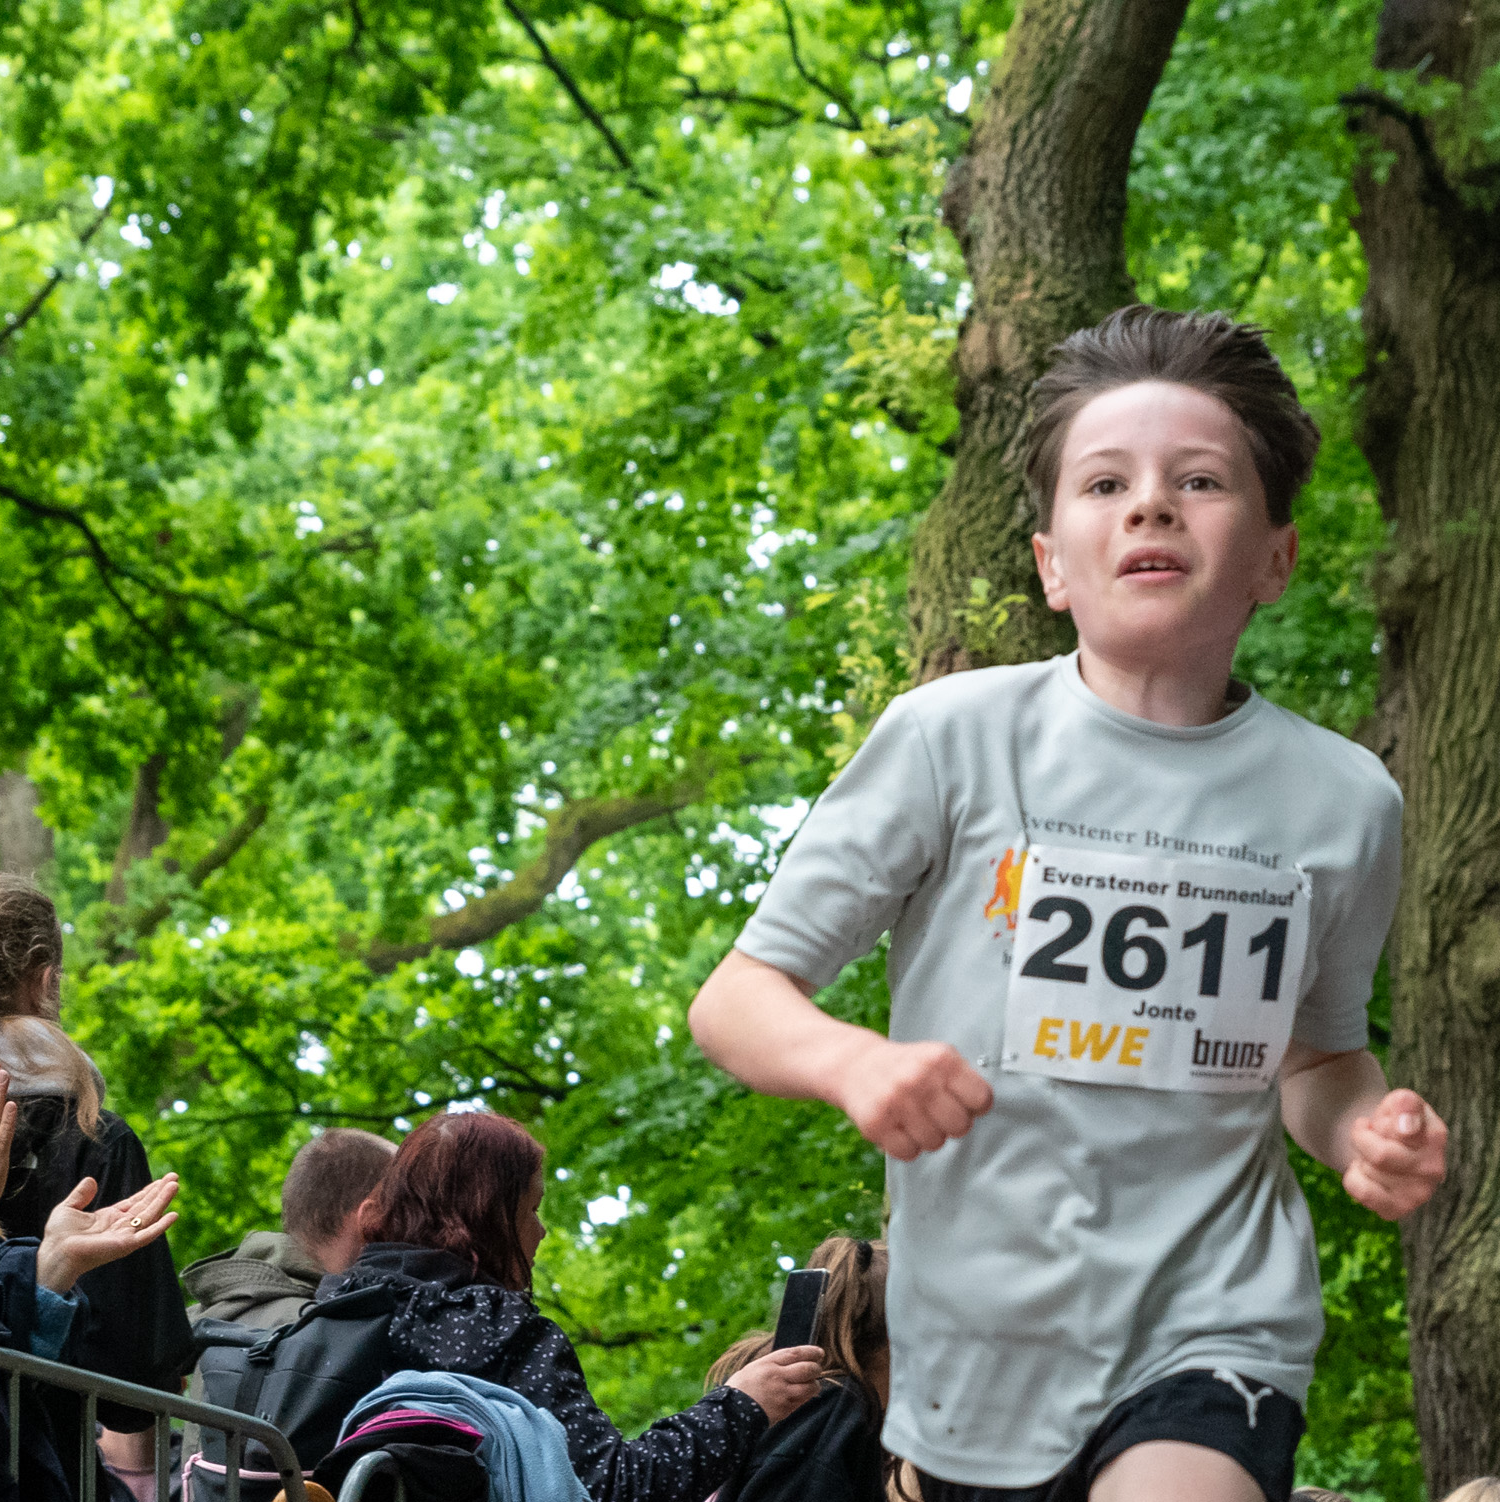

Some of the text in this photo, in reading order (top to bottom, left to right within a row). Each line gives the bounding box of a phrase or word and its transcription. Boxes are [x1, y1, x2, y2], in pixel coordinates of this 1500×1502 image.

[1145, 829, 1283, 869] Brunnenlauf
[1042, 866, 1295, 908] Everstener Brunnenlauf
[1020, 895, 1291, 1001] 2611
[1132, 1000, 1198, 1022] Jonte
[1033, 1016, 1150, 1067] EWE
[1192, 1029, 1269, 1068] bruns
